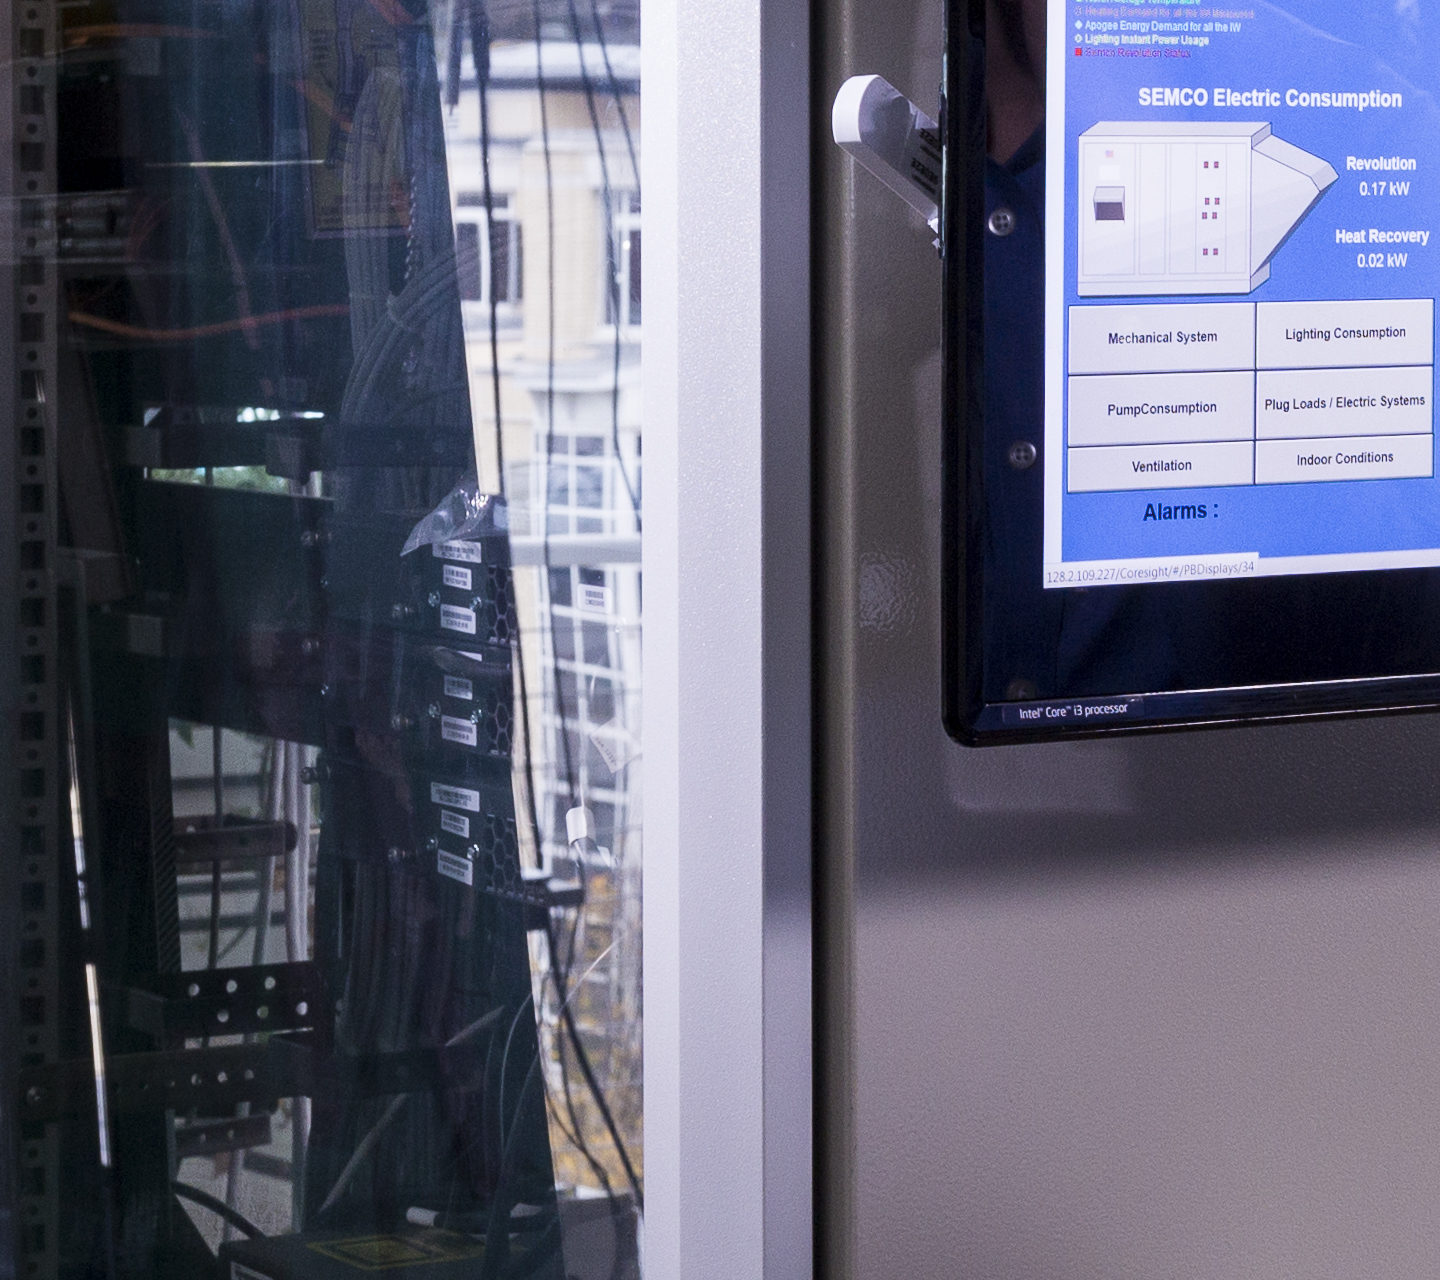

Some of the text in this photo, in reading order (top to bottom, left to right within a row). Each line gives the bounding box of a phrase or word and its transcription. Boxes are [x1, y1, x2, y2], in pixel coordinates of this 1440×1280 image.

[1085, 21, 1241, 32] Apogee Energy Demand for all the IW
[1138, 88, 1402, 112] SEMCO Electric Consumption
[1346, 156, 1416, 171] Revolution
[1359, 181, 1410, 196] 0.17 kW
[1335, 229, 1430, 246] Heat Recovery
[1357, 253, 1407, 268] 0.02 kW
[1108, 331, 1218, 346] Mechanical System
[1285, 326, 1406, 342] Lighting Consumption
[1108, 401, 1217, 418] PumpConsumption
[1265, 398, 1290, 413] Plug
[1293, 397, 1326, 411] Loads
[1337, 395, 1377, 409] Electric
[1380, 394, 1425, 409] Systems
[1132, 459, 1192, 473] Ventilation
[1297, 451, 1394, 467] Indoor Conditions
[1143, 502, 1207, 522] Alarms
[1047, 561, 1254, 583] 128.2.109.227/Coresight/#/PBDisplays/34
[1073, 704, 1082, 716] i3
[1085, 703, 1128, 718] processor
